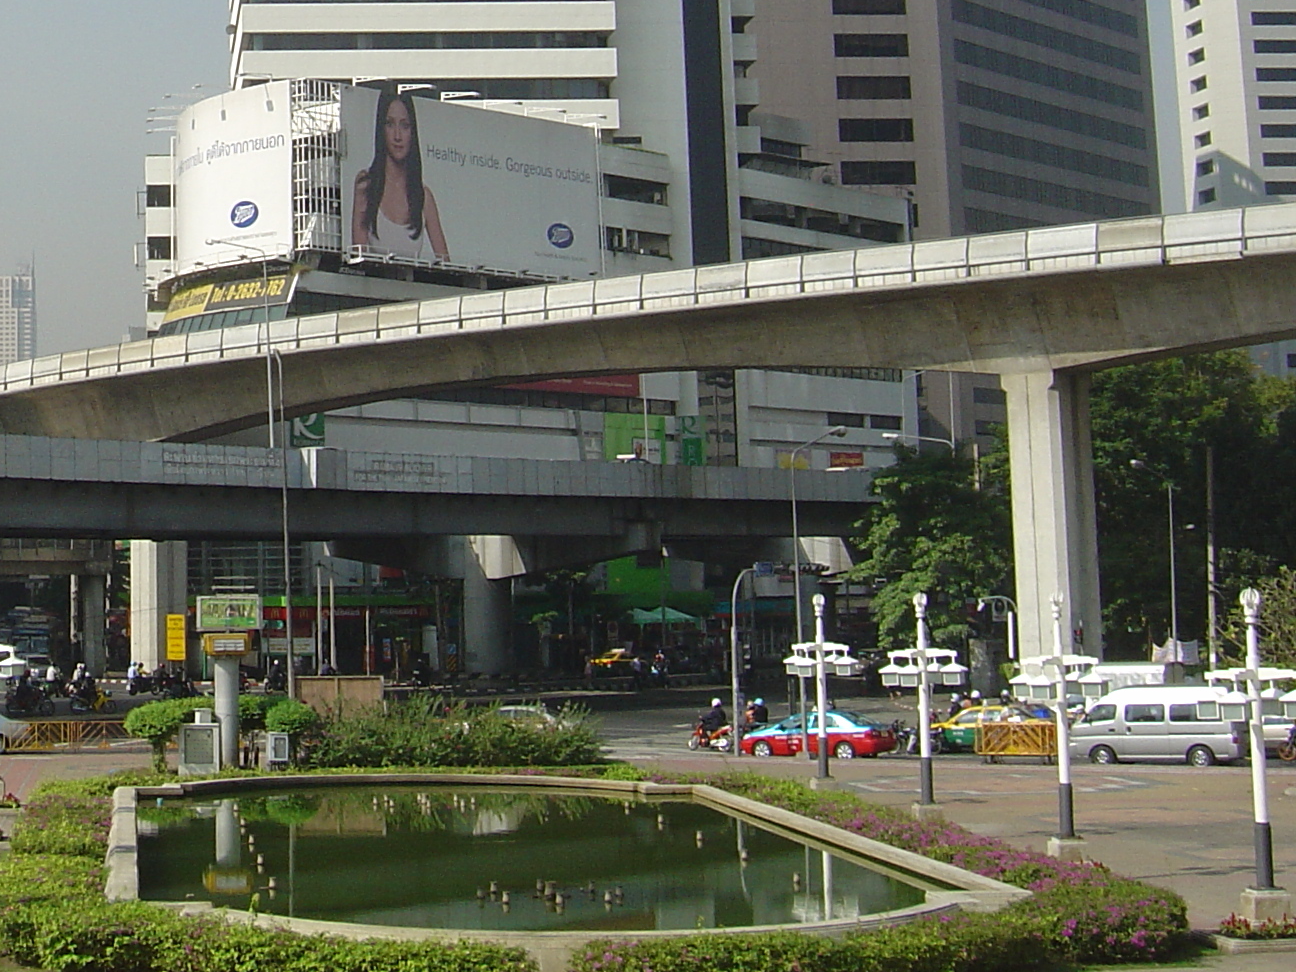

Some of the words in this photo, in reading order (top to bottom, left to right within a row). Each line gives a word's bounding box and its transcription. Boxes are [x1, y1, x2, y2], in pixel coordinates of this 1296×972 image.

[426, 145, 467, 166] Healthy
[470, 151, 502, 170] inside.
[505, 157, 553, 178] Gorgeous
[555, 167, 594, 184] outside.
